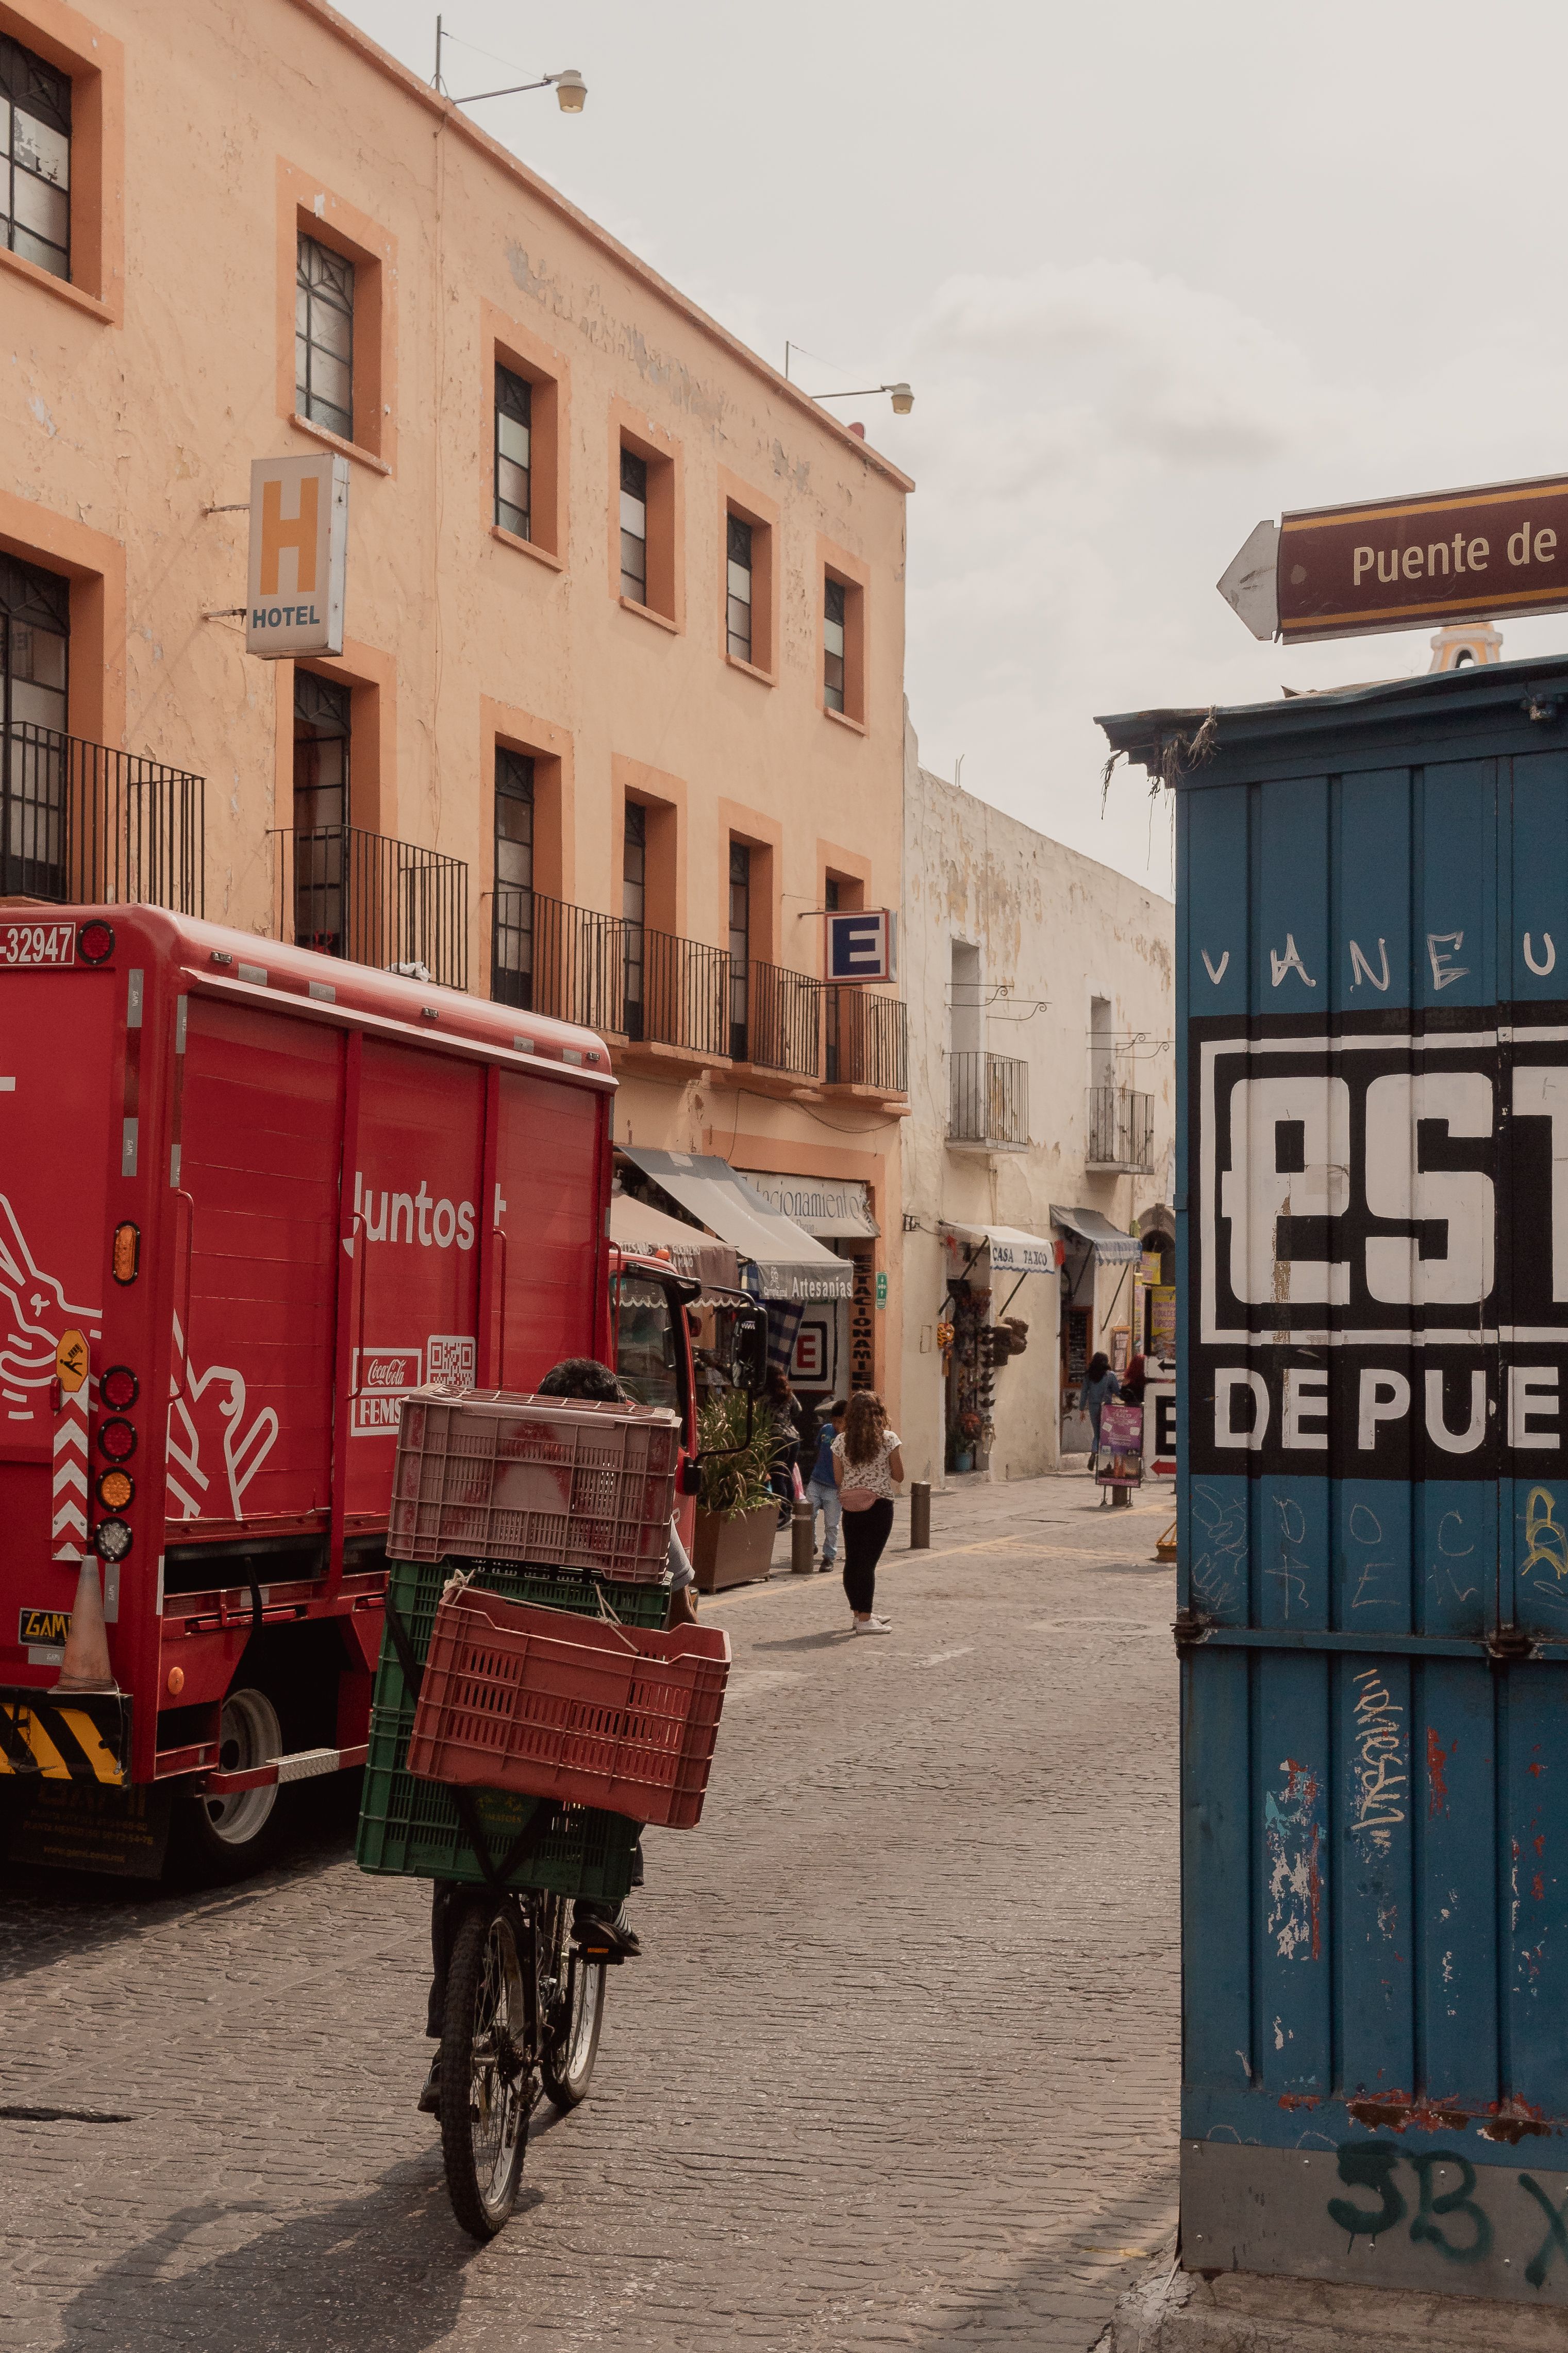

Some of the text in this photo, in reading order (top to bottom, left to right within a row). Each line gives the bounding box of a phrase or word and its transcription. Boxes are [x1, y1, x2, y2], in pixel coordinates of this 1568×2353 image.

[260, 477, 319, 596] H
[1353, 522, 1558, 586] Puente de
[252, 605, 320, 628] HOTEL
[832, 916, 881, 977] E
[992, 1247, 1047, 1266] CASA TAXCO
[792, 1276, 853, 1298] Artesanías
[368, 1359, 407, 1386] Coca-Cola
[1214, 1367, 1328, 1450] DE
